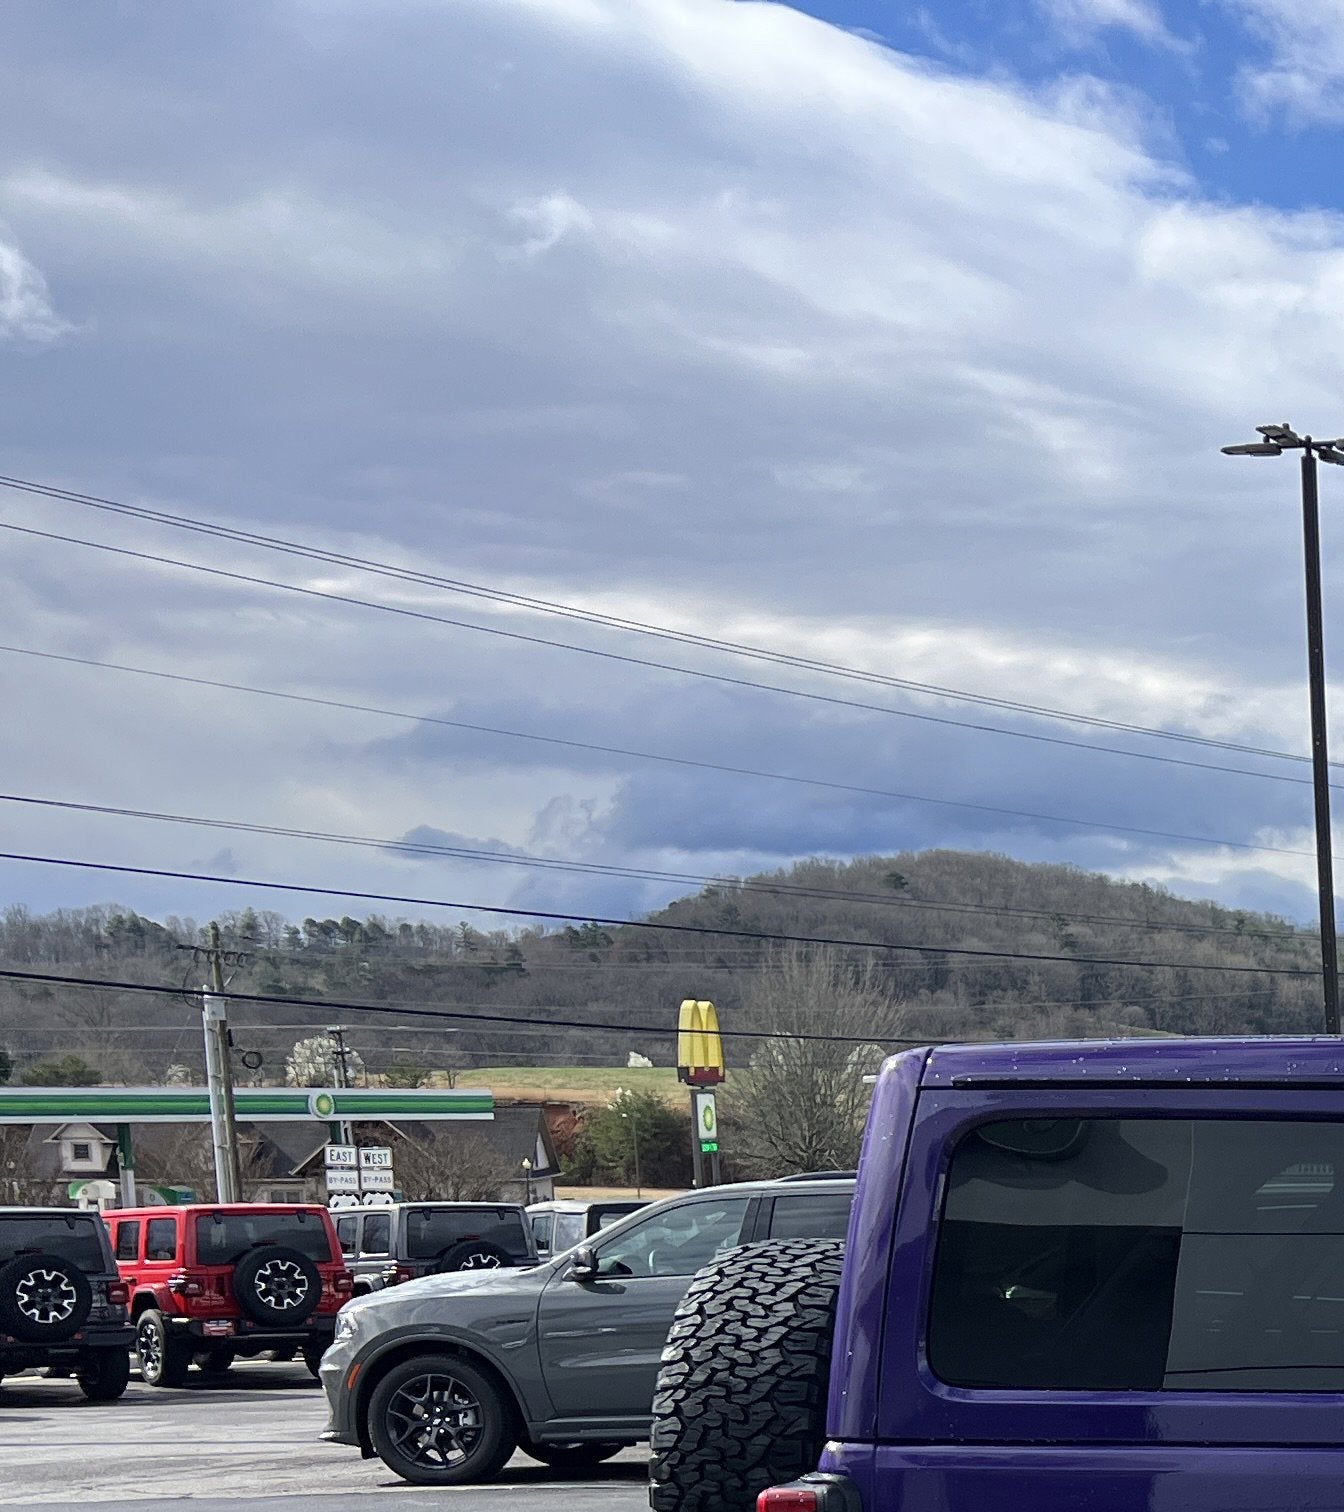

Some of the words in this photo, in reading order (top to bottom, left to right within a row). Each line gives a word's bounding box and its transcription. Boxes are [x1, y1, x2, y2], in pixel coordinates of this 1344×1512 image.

[329, 1149, 353, 1163] EAST
[363, 1152, 388, 1165] WEST
[328, 1176, 357, 1185] BY-PASS
[363, 1176, 392, 1185] BY-PASS
